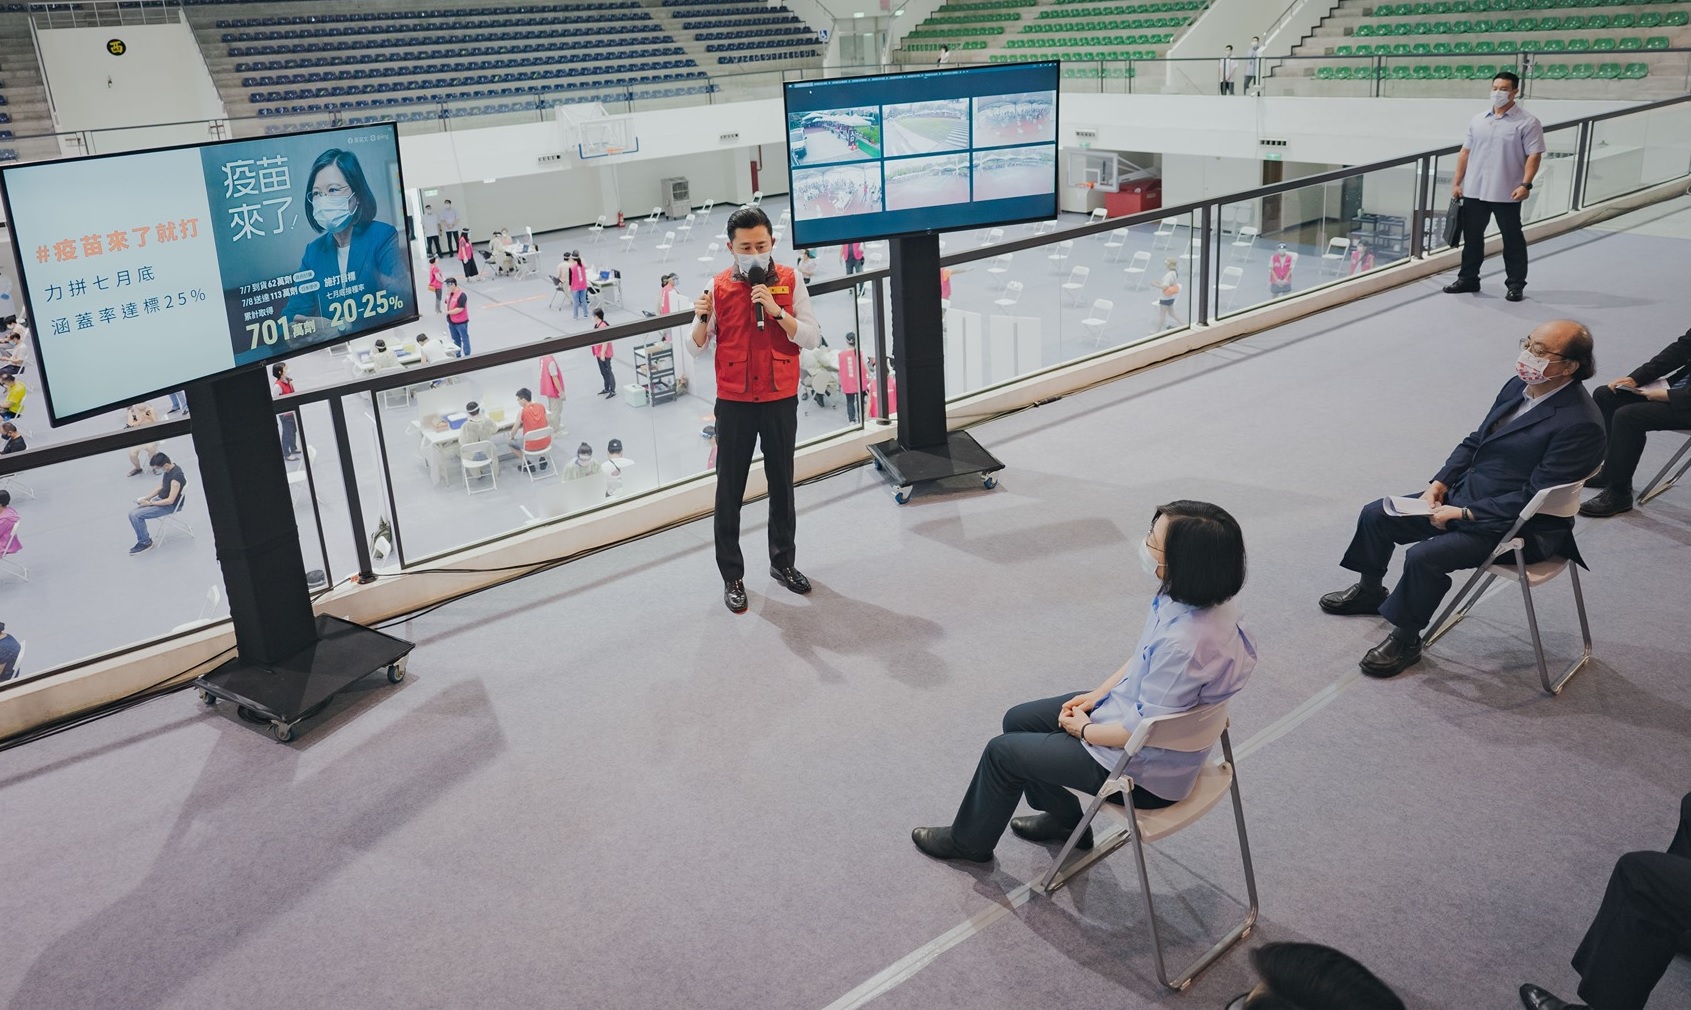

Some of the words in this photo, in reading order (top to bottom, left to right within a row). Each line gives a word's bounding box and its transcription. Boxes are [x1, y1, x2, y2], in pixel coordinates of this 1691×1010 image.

[110, 41, 123, 53] 西
[222, 155, 291, 199] 疫苗
[36, 217, 199, 264] #疫苗來了就打
[44, 265, 155, 303] 力拼七月底
[324, 271, 356, 288] 施打目標
[51, 288, 206, 336] 涵蓋率達標25%
[328, 289, 404, 328] 20-25%
